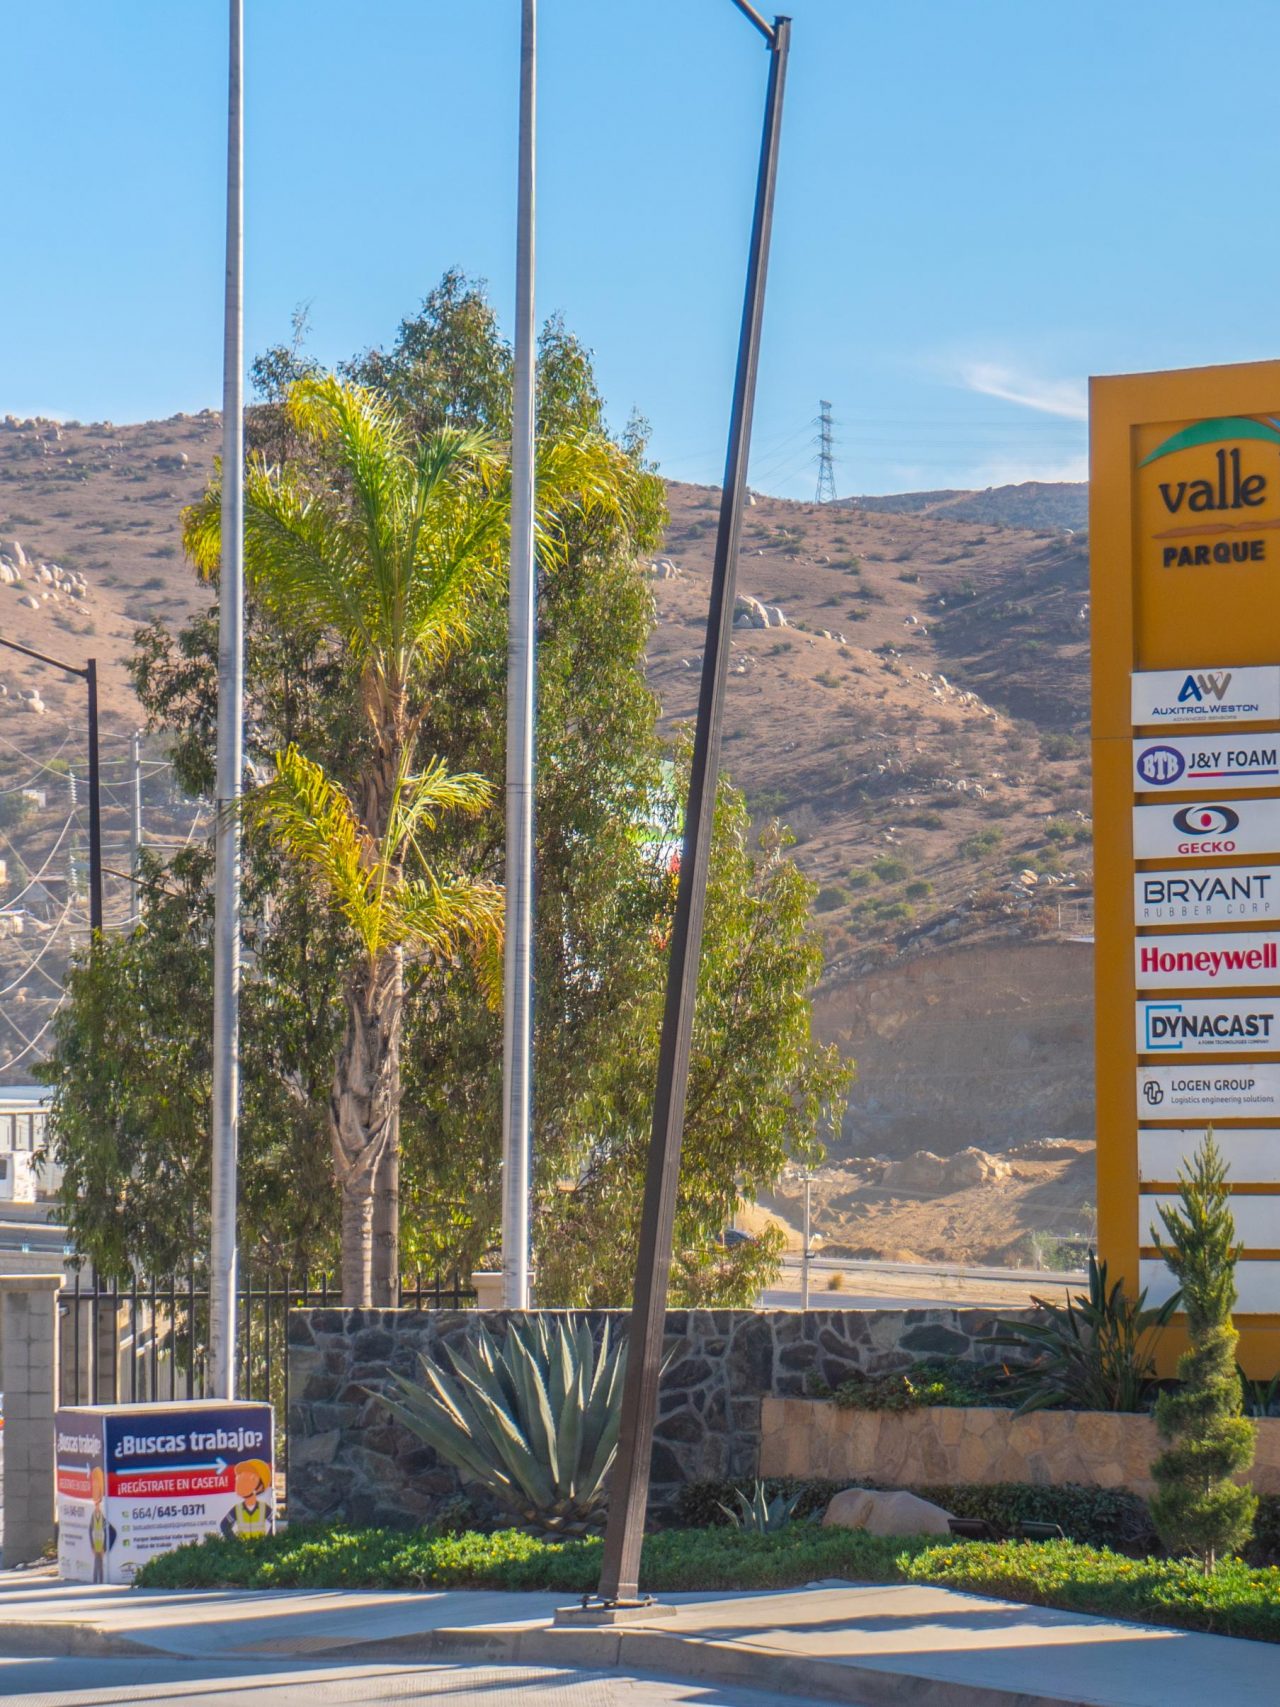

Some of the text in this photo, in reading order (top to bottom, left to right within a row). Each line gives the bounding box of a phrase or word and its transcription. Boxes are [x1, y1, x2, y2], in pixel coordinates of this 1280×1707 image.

[1158, 447, 1266, 514] valle
[1163, 539, 1266, 569] PARQUE
[1152, 703, 1259, 716] AUXITROL WESTON
[1188, 749, 1277, 770] J&Y FOAM
[1178, 840, 1236, 855] GECKO
[1144, 874, 1271, 905] BRYANT
[1144, 902, 1270, 918] RUBBER CORP
[1140, 942, 1277, 977] Honeywell
[1151, 1013, 1274, 1038] DYNACAST
[1171, 1079, 1255, 1091] LOGEN GROUP
[1171, 1094, 1274, 1105] Logistics engineering solutions
[114, 1427, 263, 1458] ¿Buscas trabajo?
[118, 1476, 229, 1495] ¡REGÍSTRATE EN CASETA!
[132, 1504, 205, 1520] 664/645-0371
